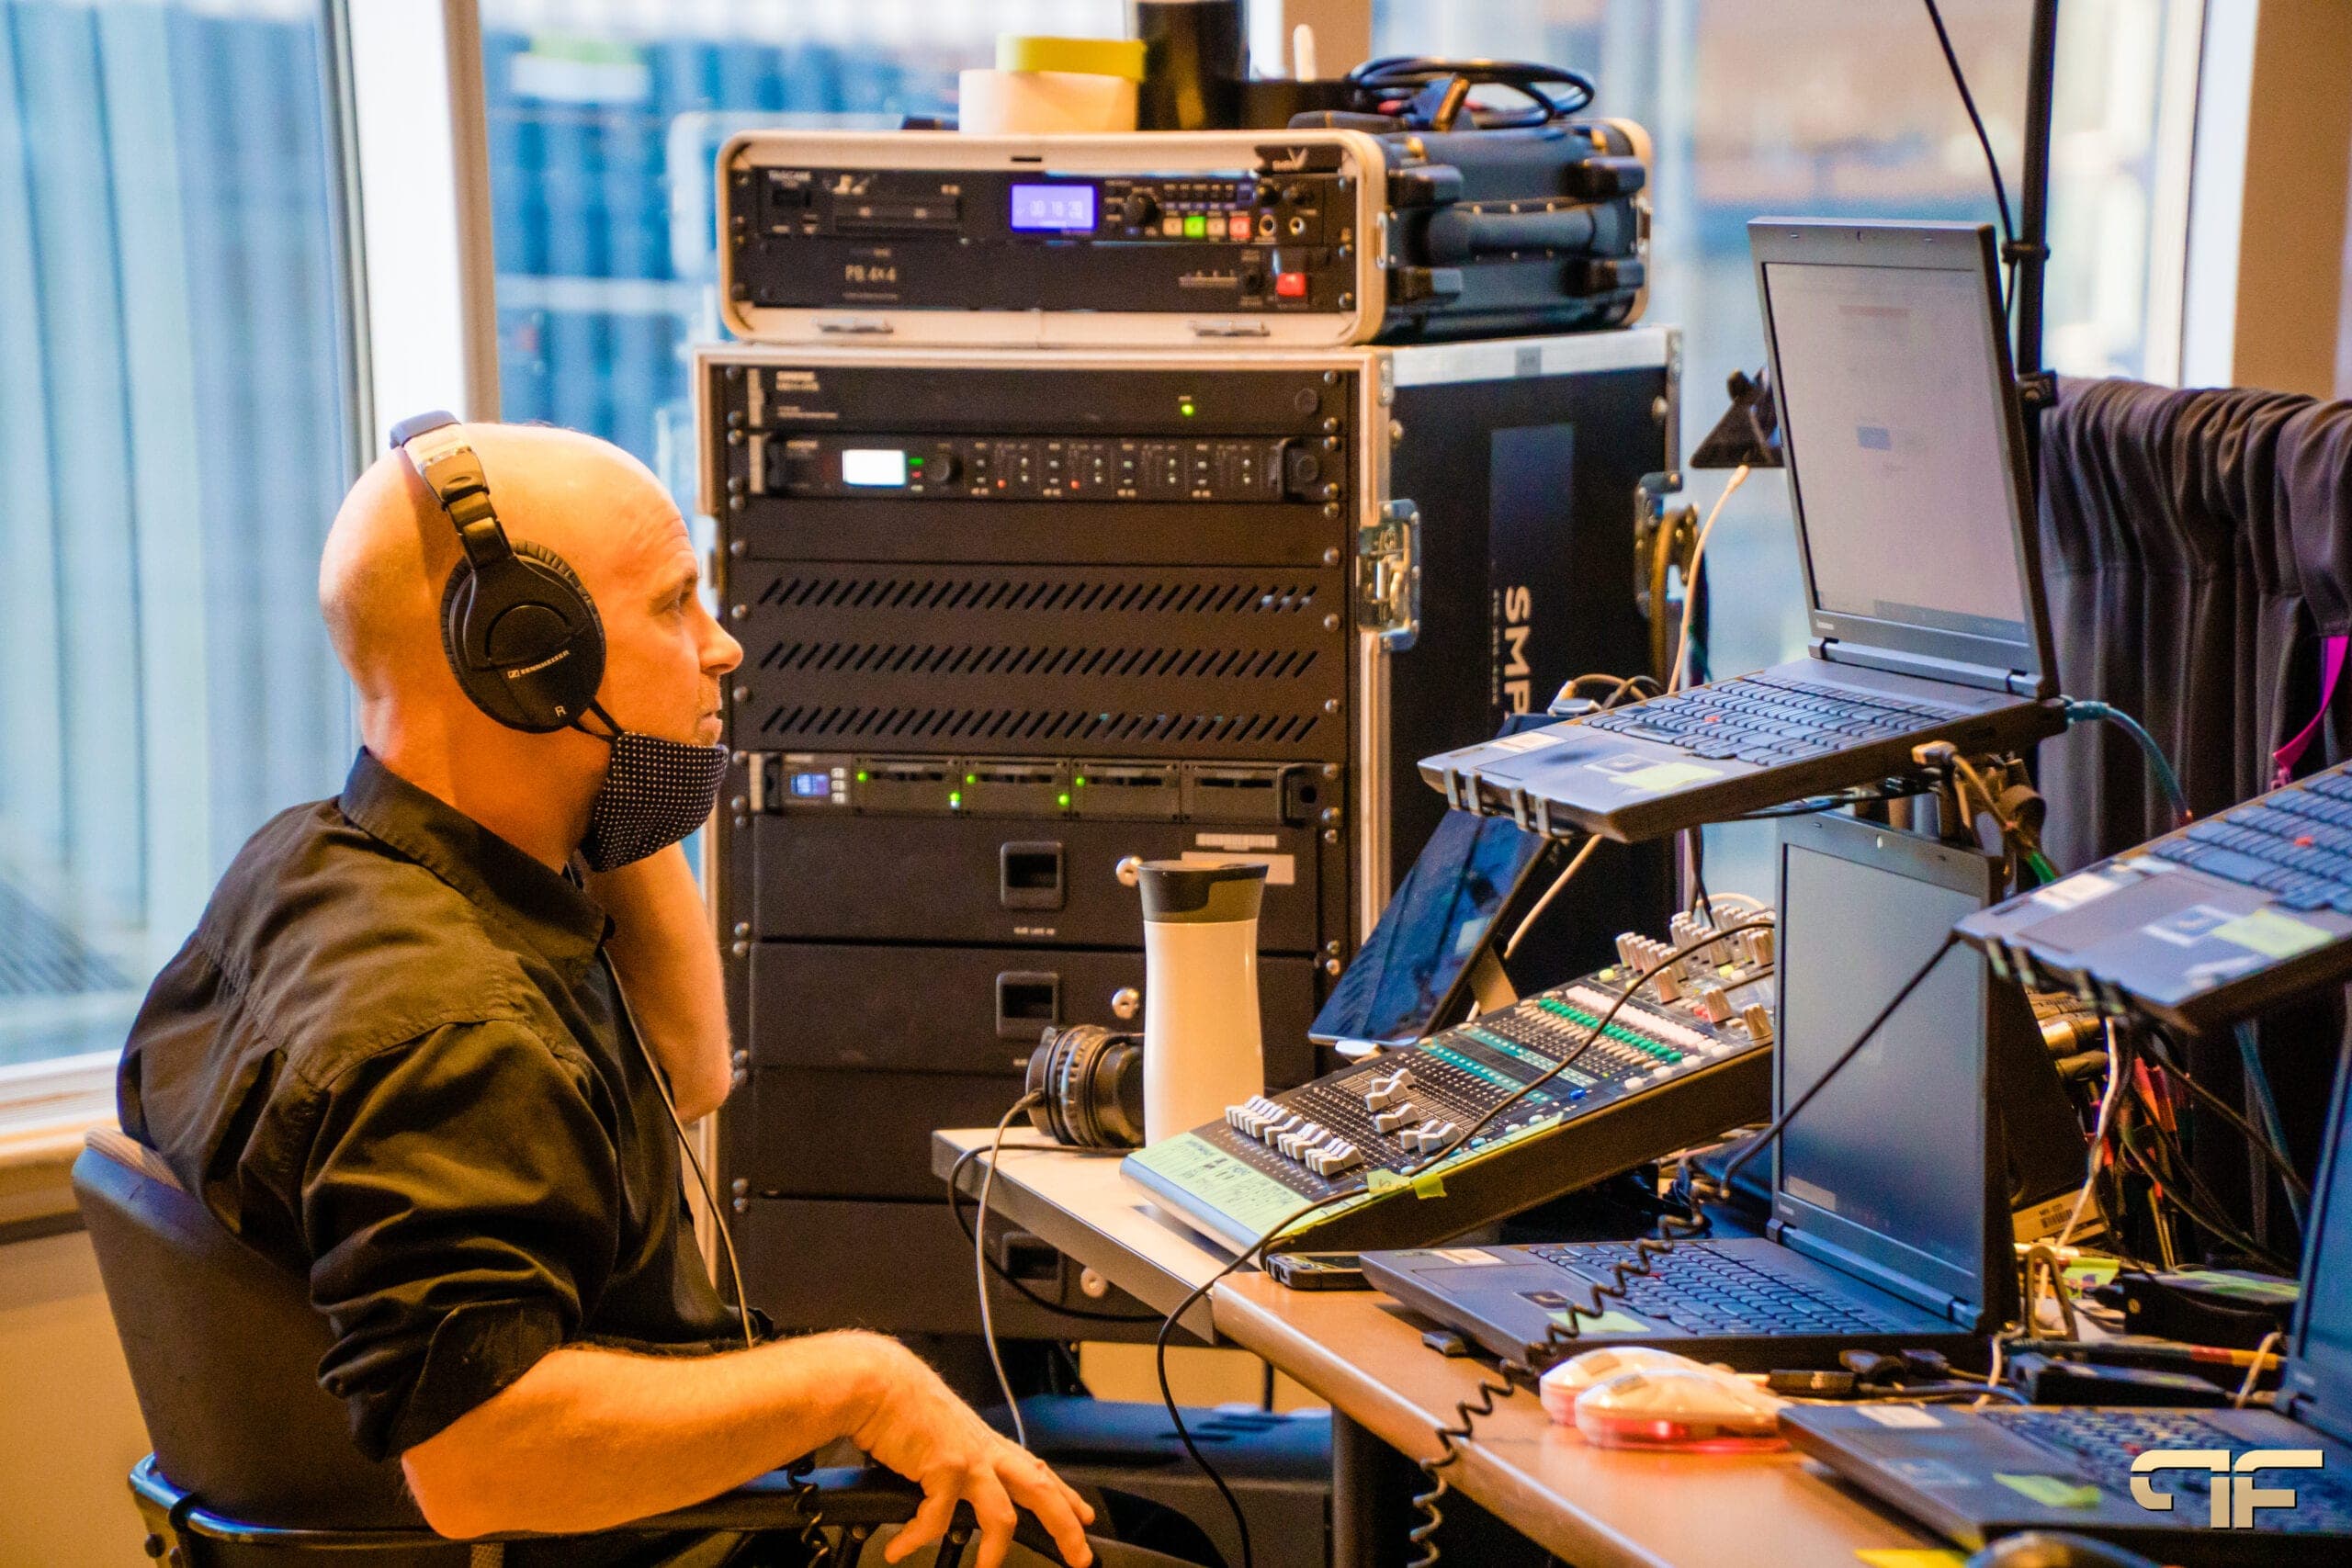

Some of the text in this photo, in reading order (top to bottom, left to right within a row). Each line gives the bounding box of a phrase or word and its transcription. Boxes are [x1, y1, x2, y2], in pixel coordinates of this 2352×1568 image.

[520, 649, 571, 675] SENNHEISER
[1504, 586, 1532, 721] SMP
[554, 705, 567, 717] R
